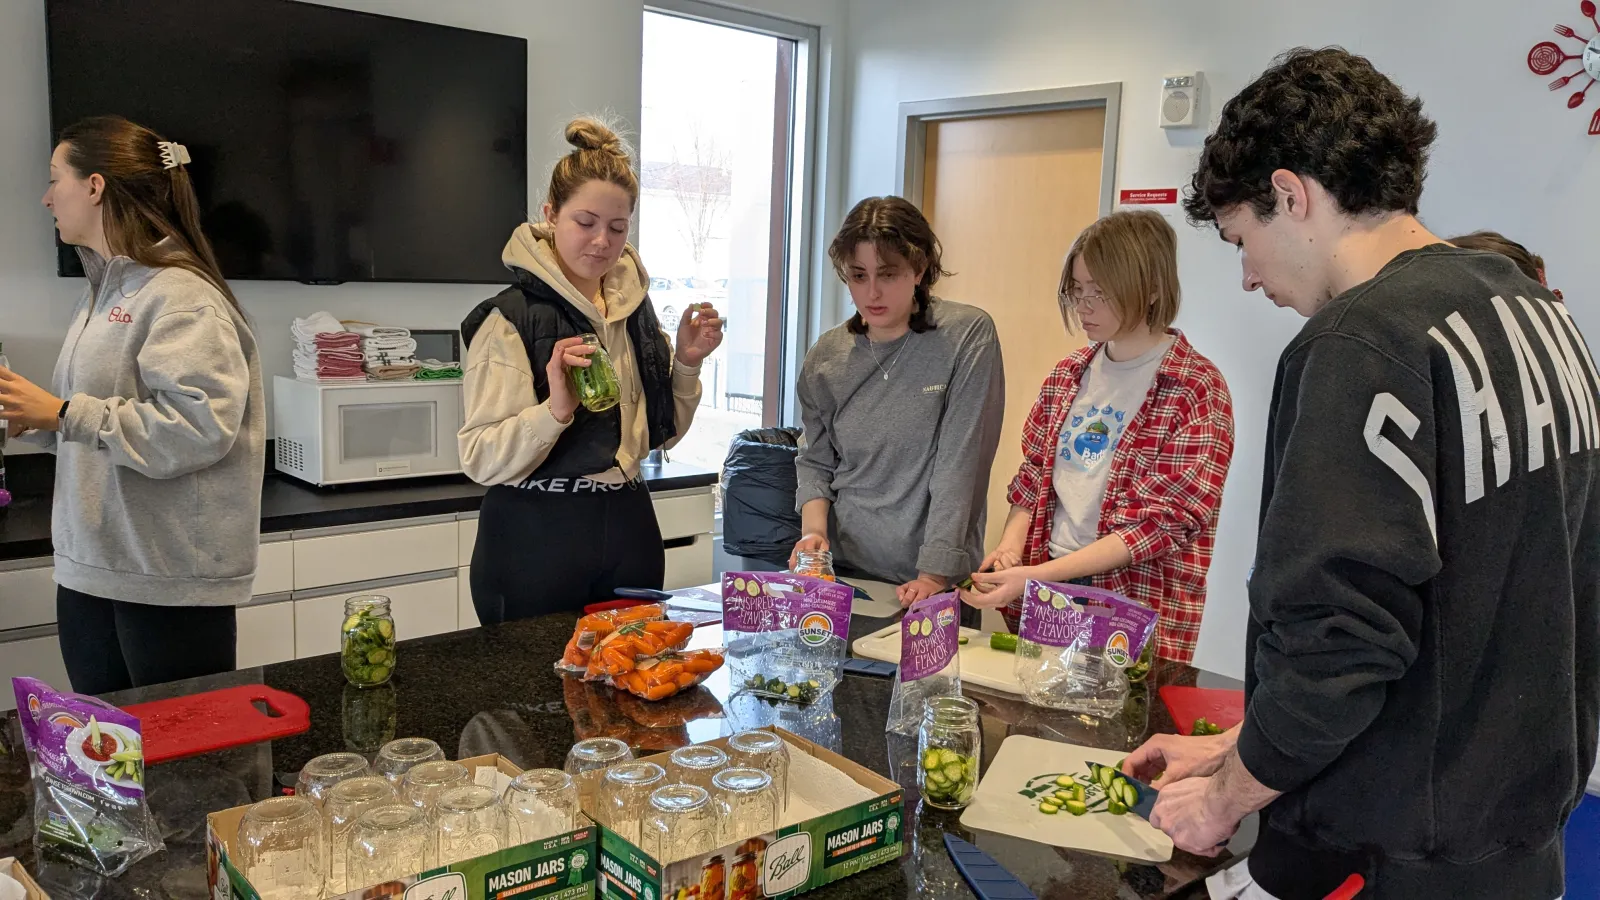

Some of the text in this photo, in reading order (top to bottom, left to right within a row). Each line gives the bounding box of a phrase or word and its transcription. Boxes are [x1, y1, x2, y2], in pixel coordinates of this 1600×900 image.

[504, 478, 570, 493] IKE
[1034, 604, 1082, 625] INSPIRED
[799, 628, 832, 638] SUNSET
[909, 627, 946, 656] INSPIRED
[1036, 620, 1077, 639] FLAVOR
[915, 642, 949, 671] FLAVOR
[827, 827, 860, 851] MASON
[860, 819, 884, 838] JARS
[488, 857, 565, 893] MASON JARS
[600, 853, 623, 881] MASON
[624, 870, 642, 893] JARS
[769, 844, 806, 882] Ball
